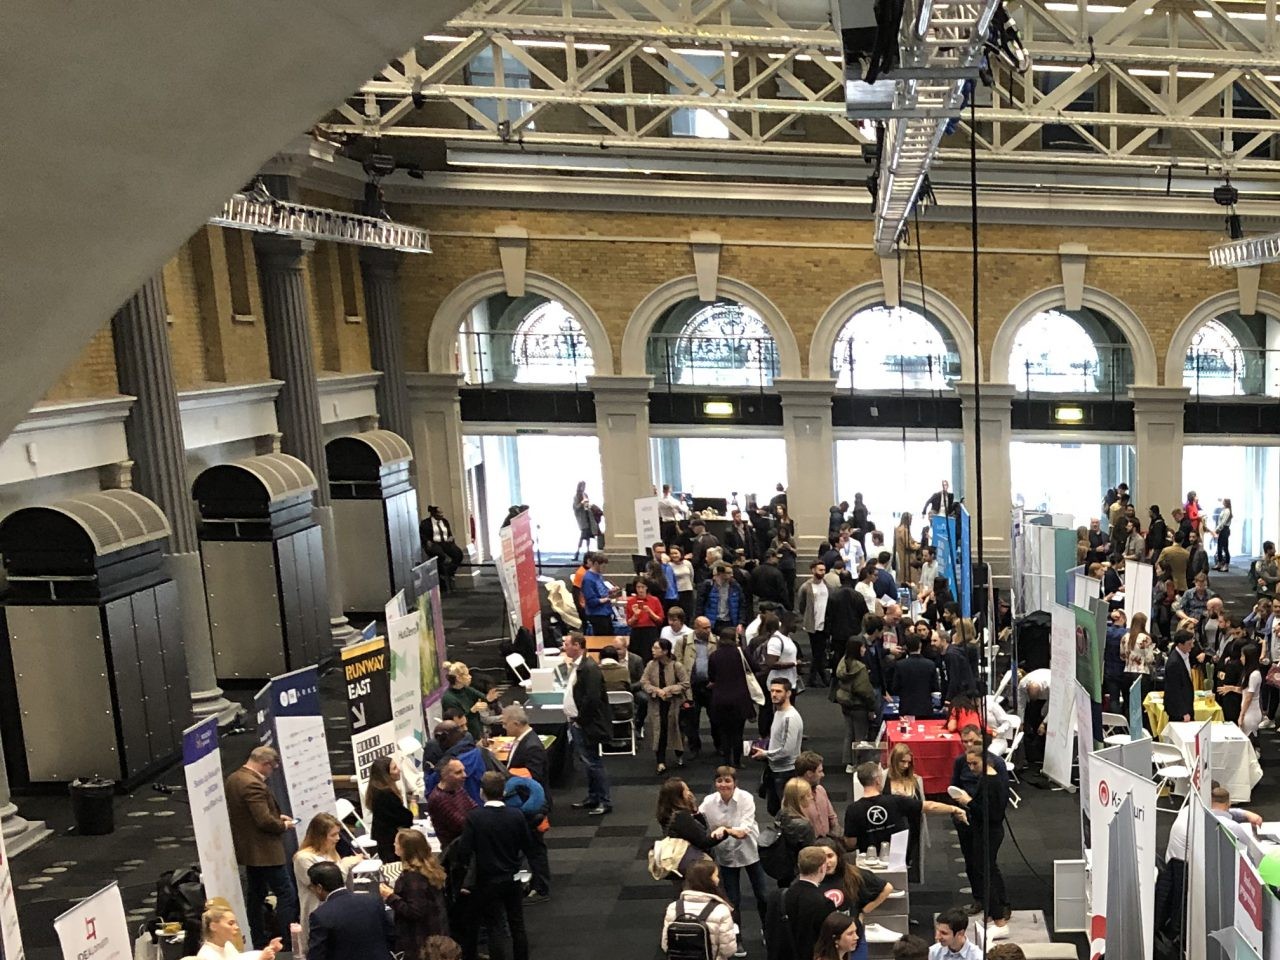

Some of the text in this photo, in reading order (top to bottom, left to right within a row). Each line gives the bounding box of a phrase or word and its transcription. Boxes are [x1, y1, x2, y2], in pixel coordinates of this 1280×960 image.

[345, 653, 385, 681] RUNWAY
[347, 678, 372, 700] EAST
[1111, 790, 1145, 822] Kauri
